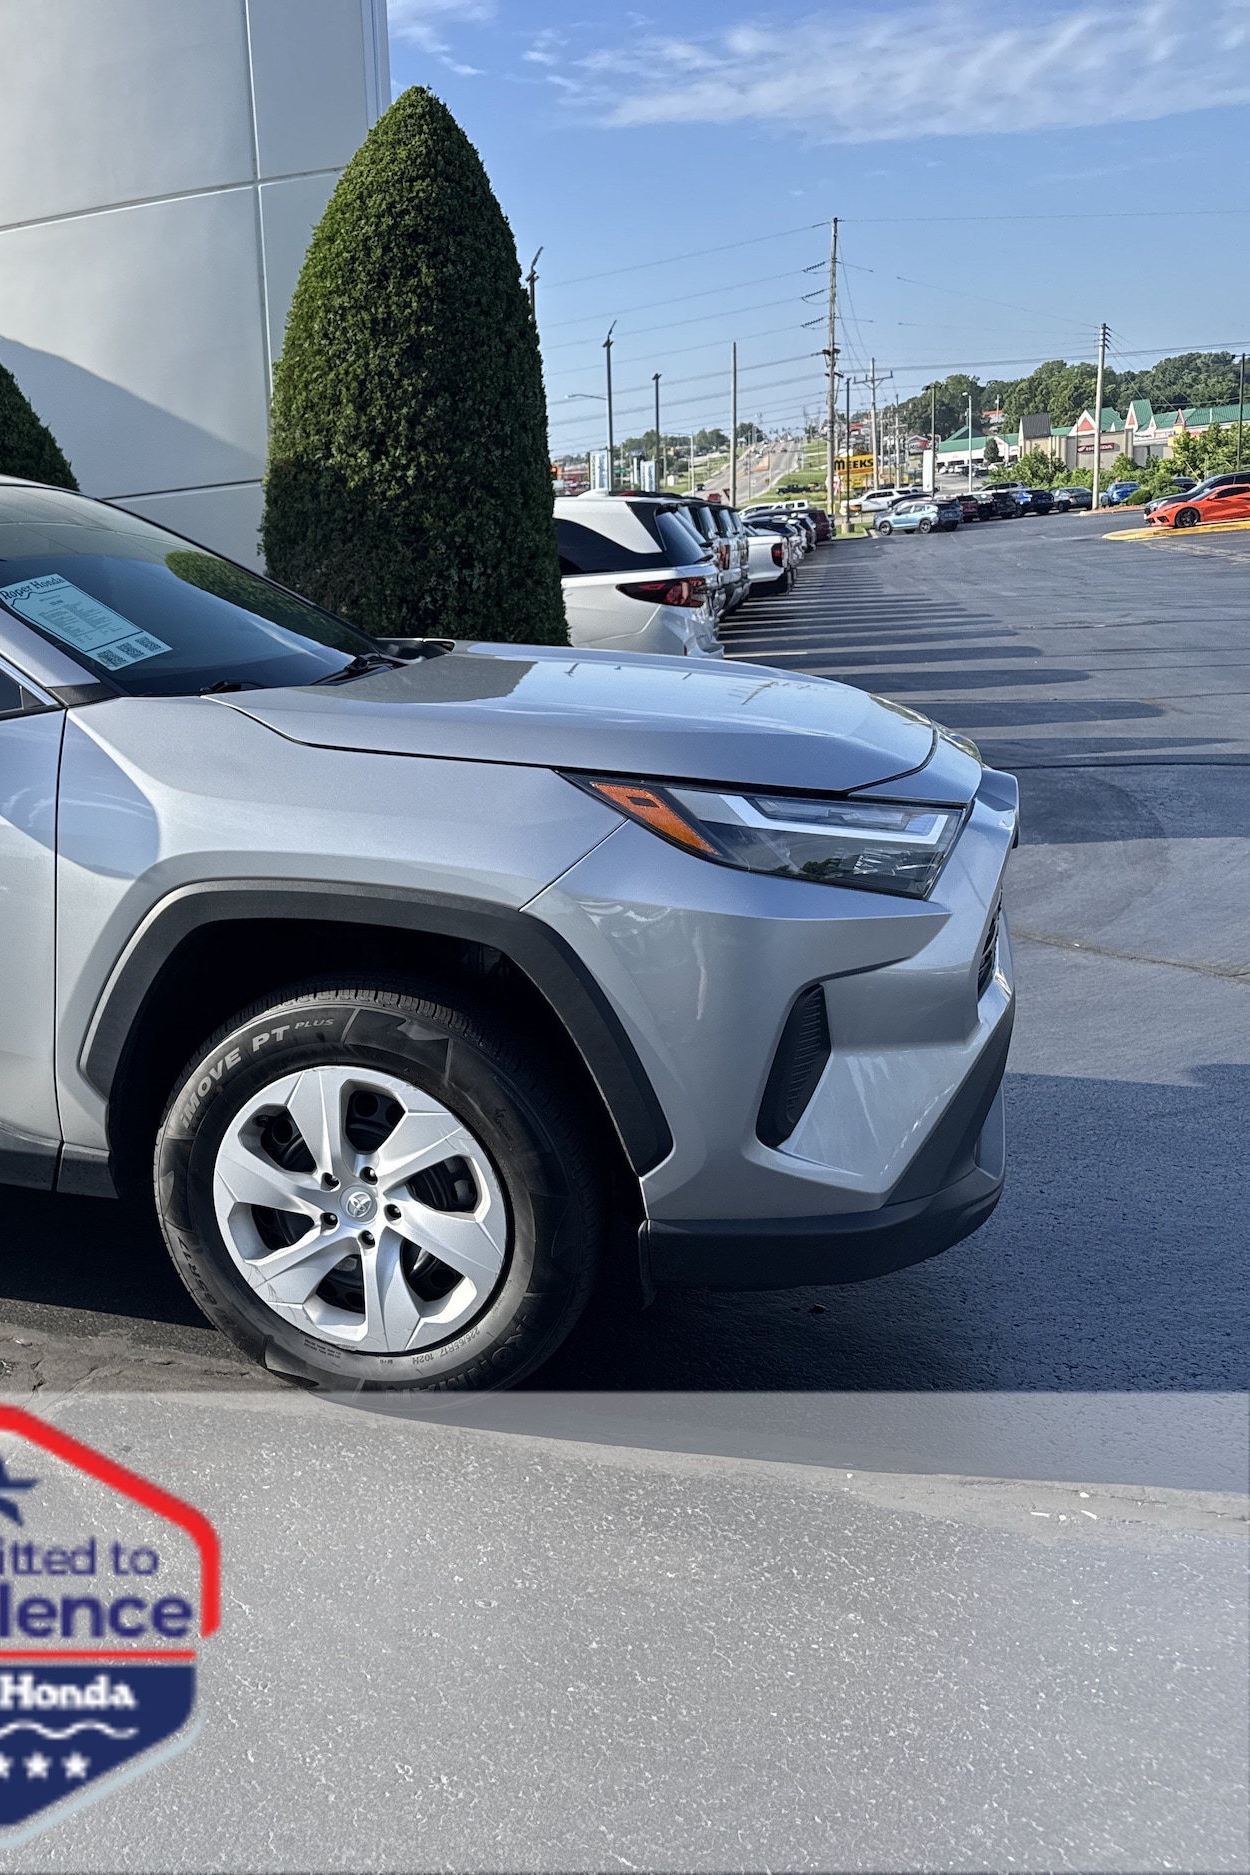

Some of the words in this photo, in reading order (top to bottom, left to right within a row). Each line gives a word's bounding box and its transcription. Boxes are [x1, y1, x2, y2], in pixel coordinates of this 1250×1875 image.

[834, 459, 873, 470] MEEKS
[30, 576, 66, 589] Honda
[252, 1025, 291, 1052] PT
[295, 1018, 335, 1030] PLUS
[439, 1326, 481, 1358] 225/65R17
